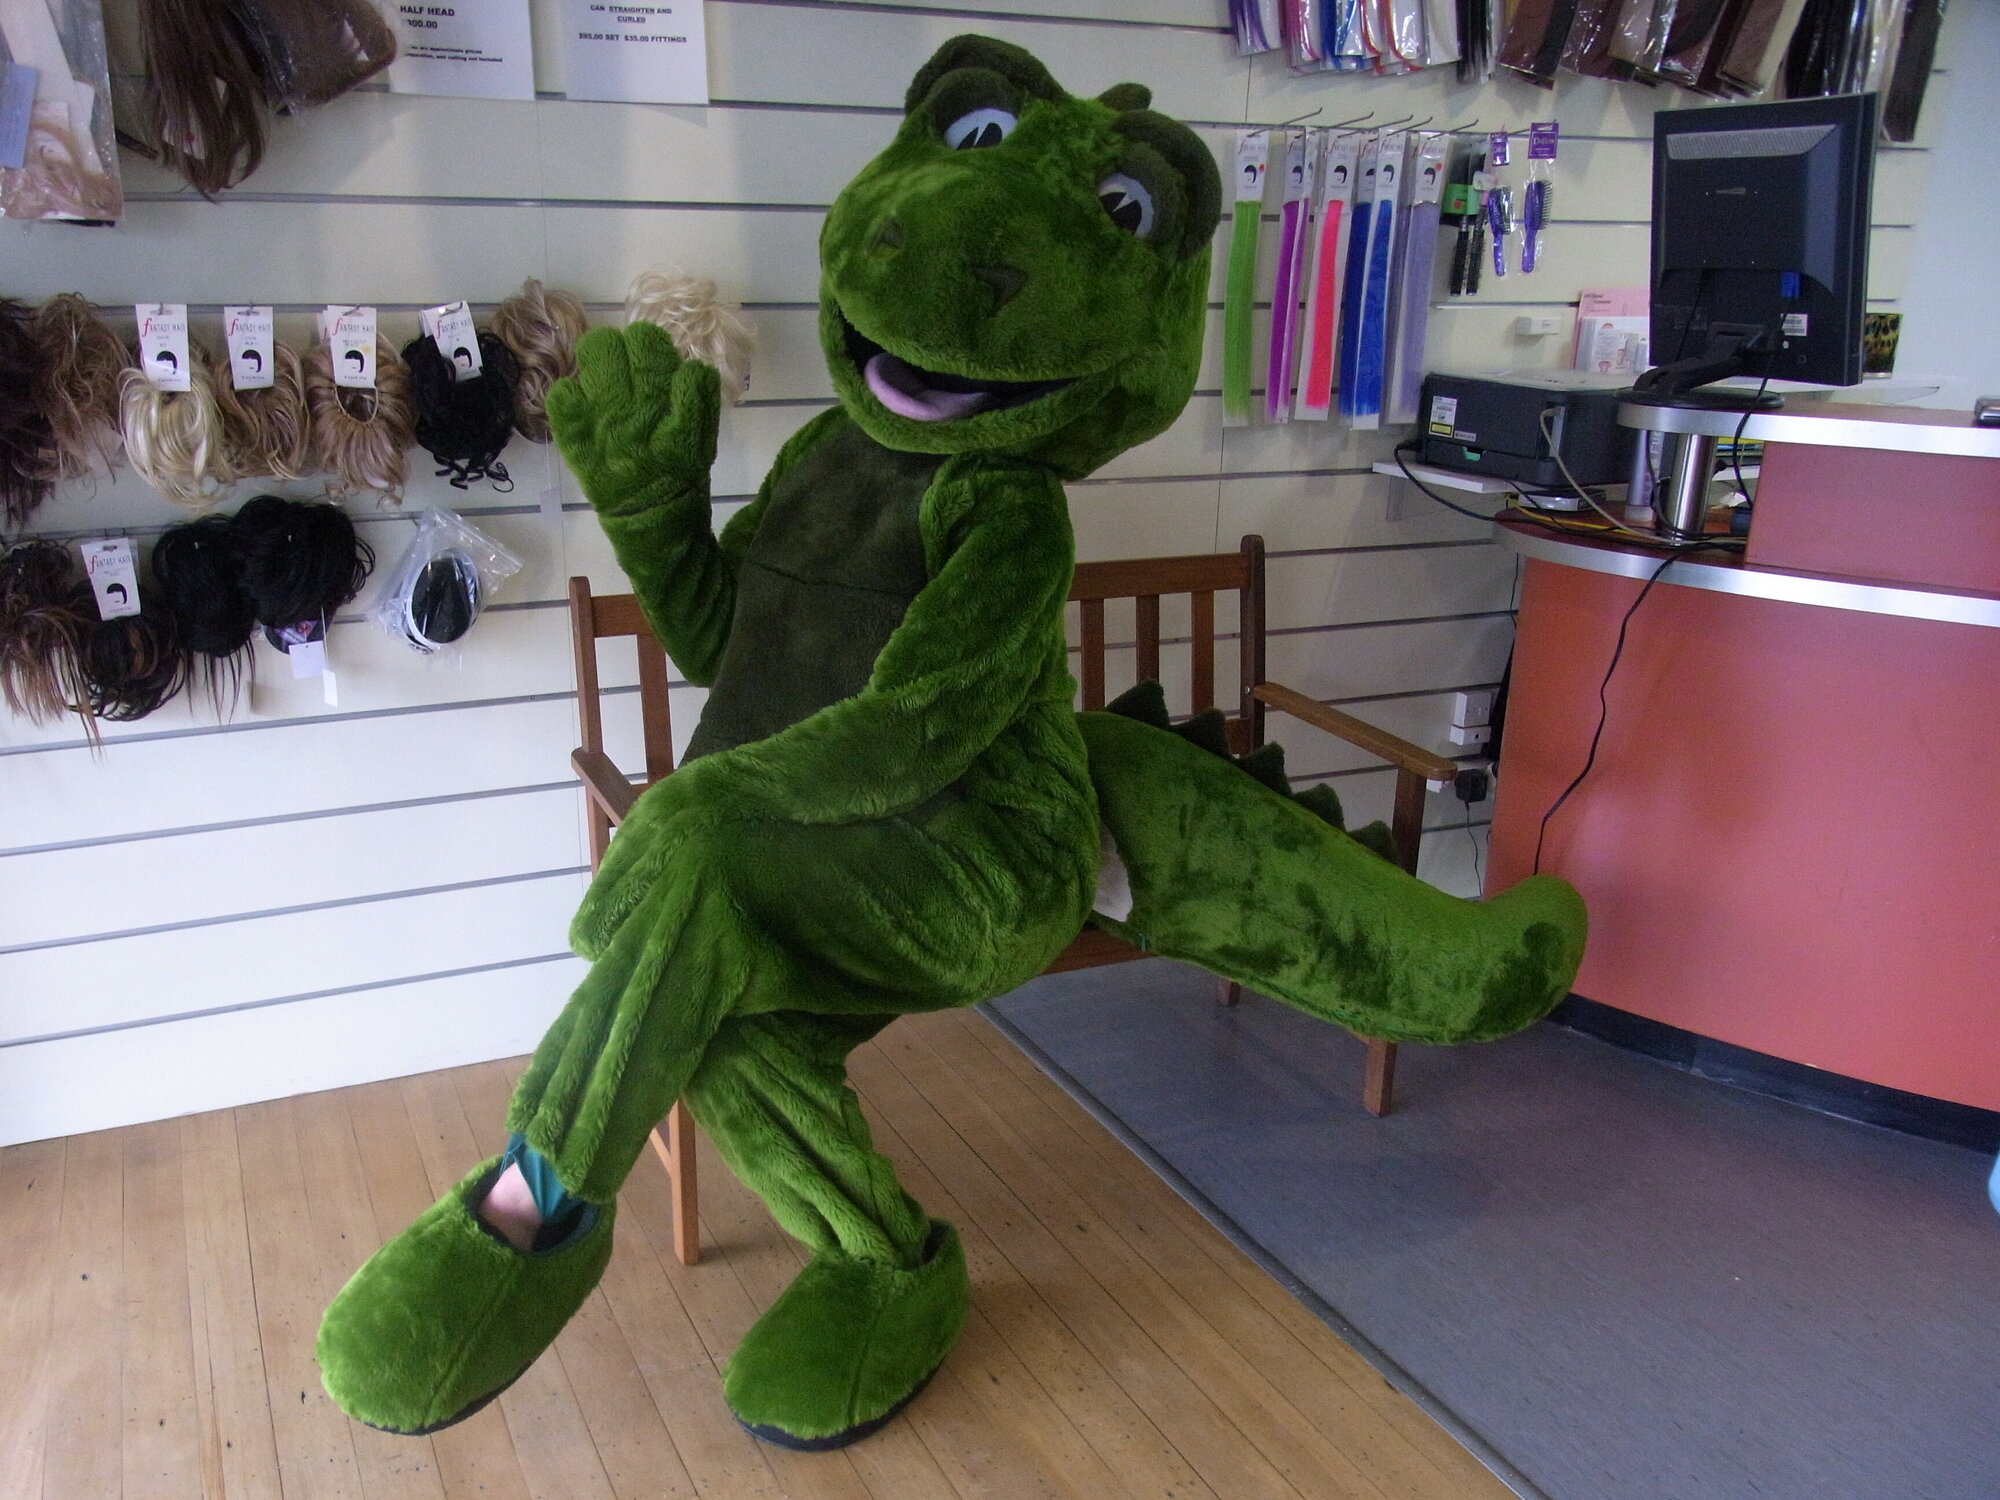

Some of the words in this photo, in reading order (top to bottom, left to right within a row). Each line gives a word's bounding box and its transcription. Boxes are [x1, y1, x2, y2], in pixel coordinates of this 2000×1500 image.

[400, 6, 424, 15] HALF
[427, 7, 455, 16] HEAD
[609, 6, 655, 14] STRAIGHTEN
